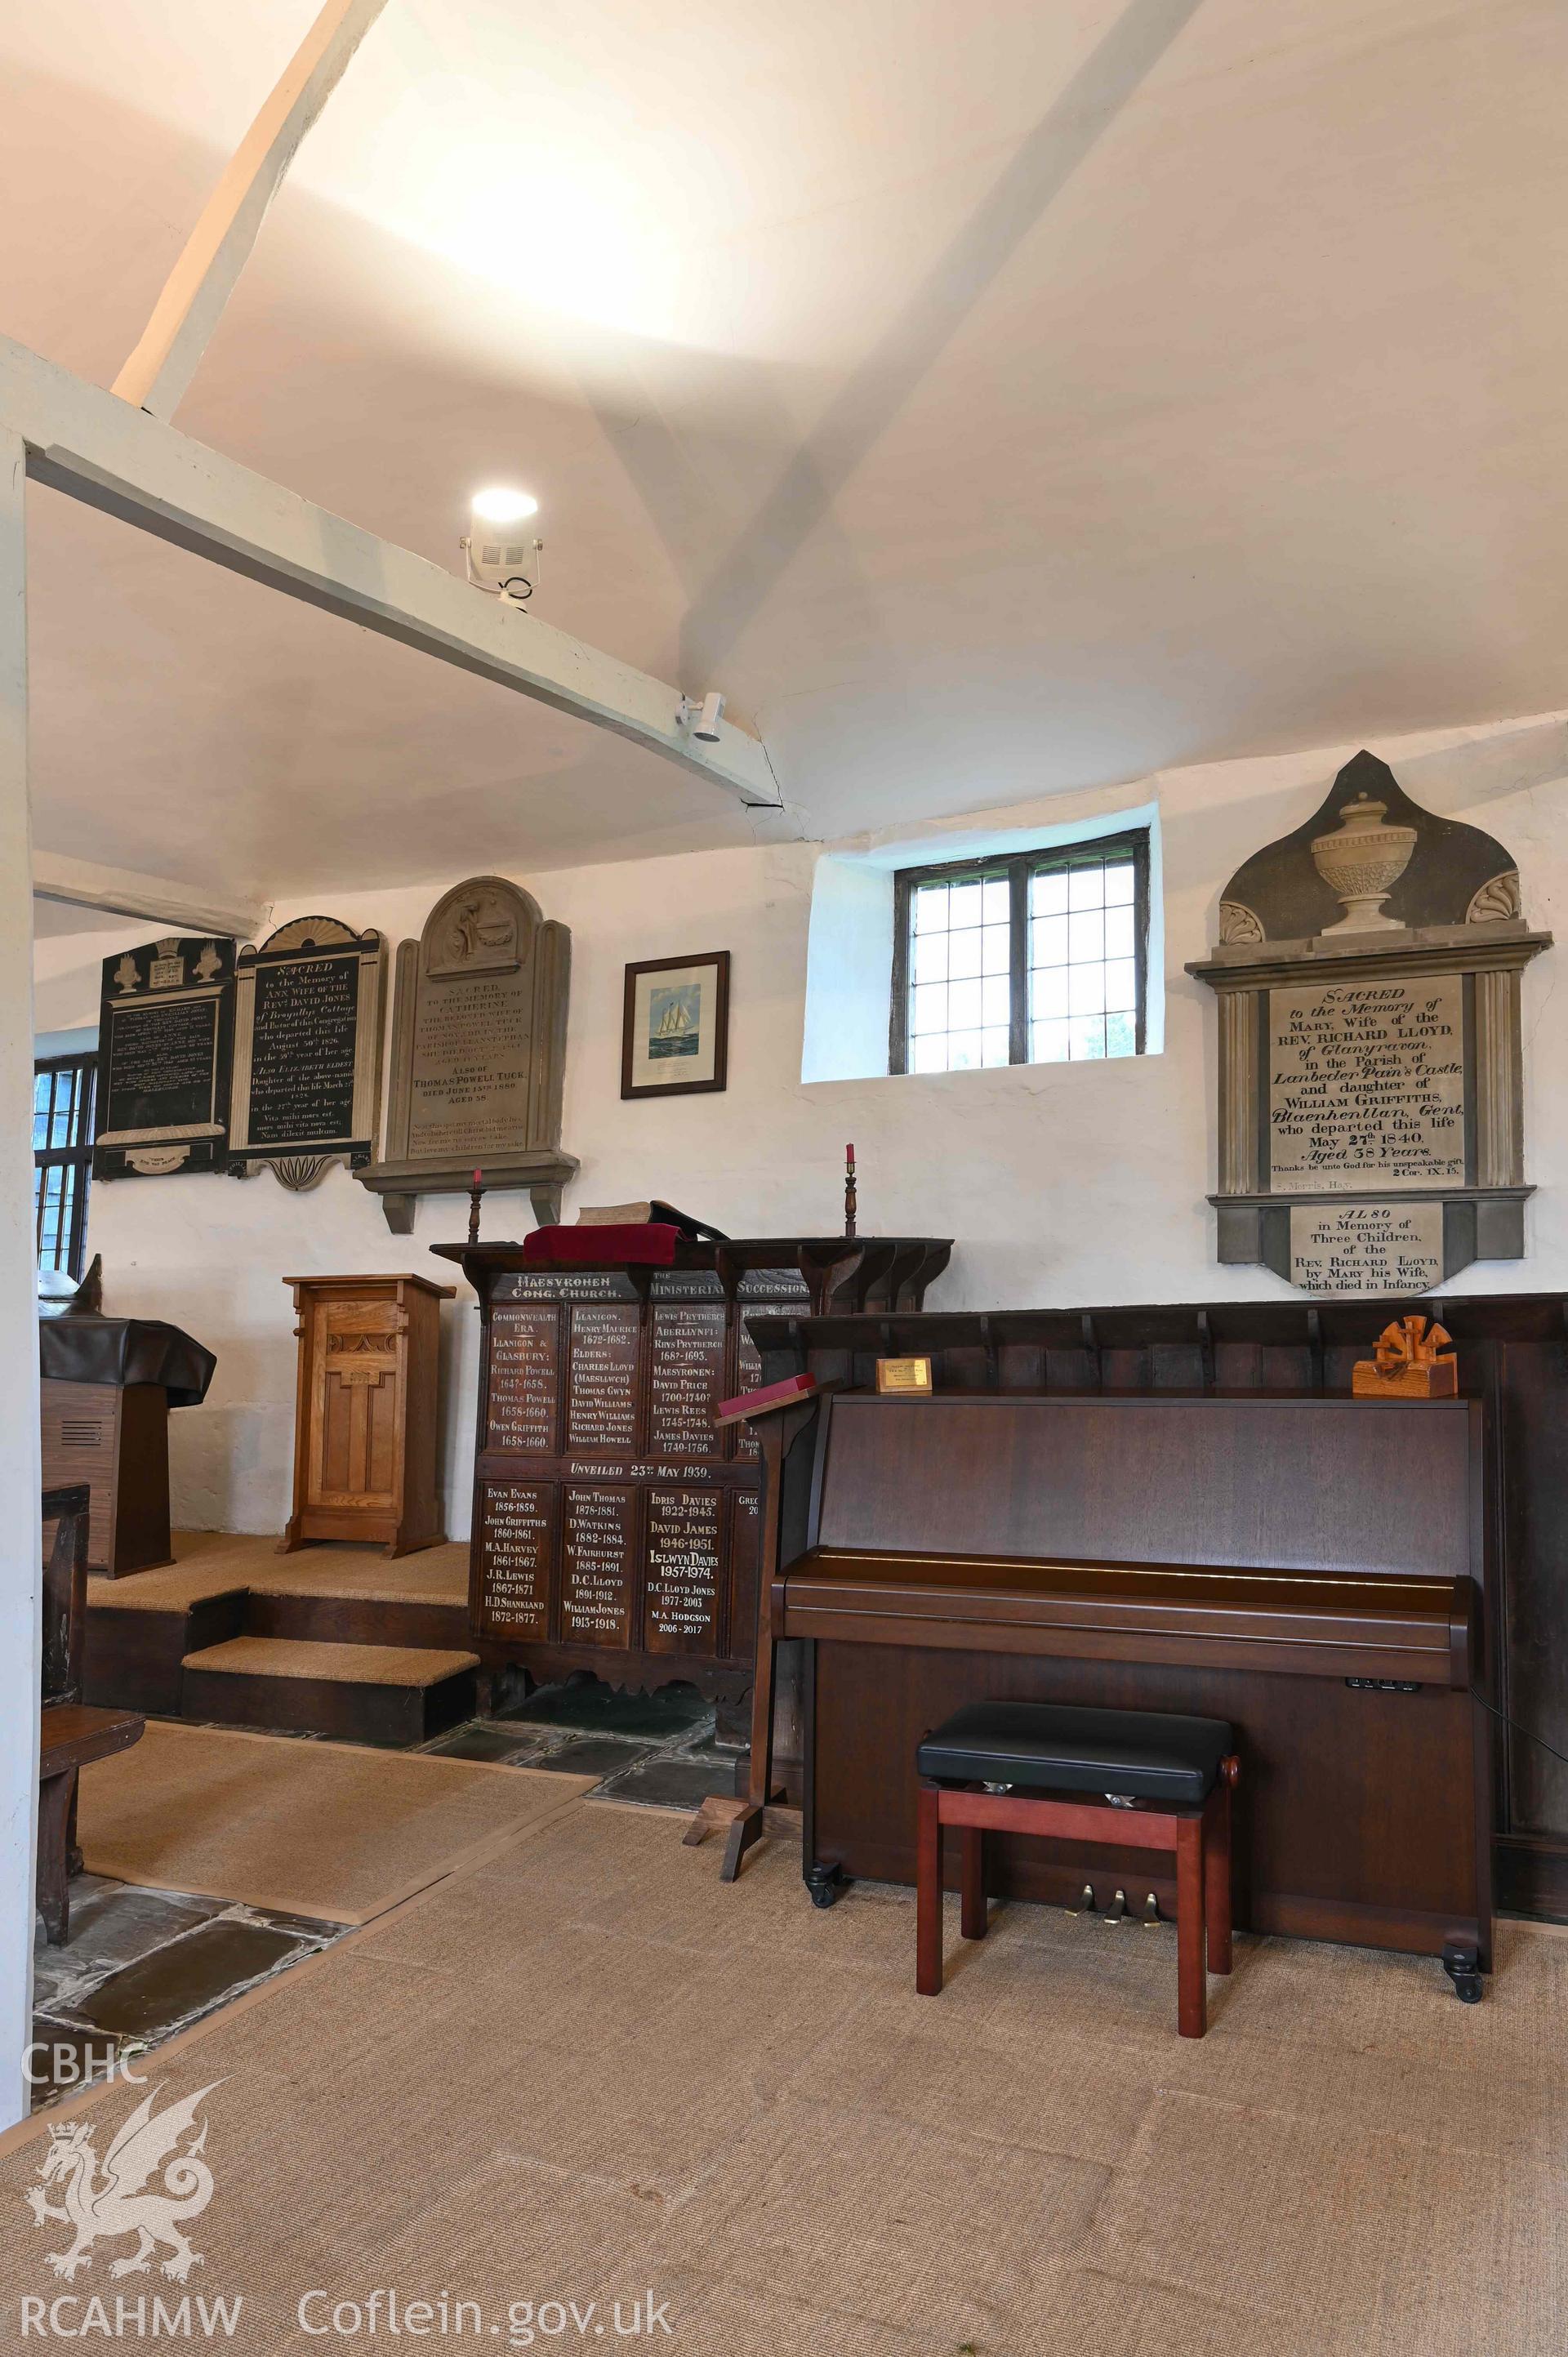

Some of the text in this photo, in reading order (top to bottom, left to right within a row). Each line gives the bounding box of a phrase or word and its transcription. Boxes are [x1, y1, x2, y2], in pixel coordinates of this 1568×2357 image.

[1321, 988, 1405, 1004] SACRED
[1290, 997, 1442, 1018] to the Memory of
[1343, 1017, 1377, 1027] Wife
[1392, 1014, 1405, 1025] of
[1416, 1012, 1438, 1023] the
[1317, 1029, 1388, 1043] RICHARD
[1298, 1045, 1316, 1060] of
[1306, 1053, 1426, 1070] in the Parish of
[1300, 1077, 1431, 1094] and daughter of
[1285, 1097, 1349, 1109] WILLIAM
[1278, 1117, 1454, 1135] who departed this life
[1309, 1137, 1340, 1149] May
[1301, 1148, 1348, 1164] Aged
[1339, 1210, 1391, 1219] ALSO
[1319, 1220, 1411, 1232] in Memory of
[1311, 1233, 1350, 1244] Three
[1343, 1244, 1386, 1254] of the
[1330, 1257, 1388, 1267] RICHARD
[1307, 1269, 1321, 1280] by
[1328, 1268, 1364, 1278] MARY
[1371, 1268, 1391, 1277] his
[1298, 1280, 1331, 1290] which
[1336, 1279, 1361, 1290] died
[1367, 1279, 1378, 1289] in
[574, 1324, 637, 1333] HENRY MAURICE
[573, 1348, 612, 1358] ELDERS:
[572, 1362, 634, 1371] CHARLES LLOYD
[573, 1385, 630, 1395] THOMAS GWYN
[572, 1398, 632, 1408] DAVID WILLIAMS
[570, 1410, 635, 1420] HENRY WILLIAMS
[572, 1422, 633, 1432] RICHARD JONES
[569, 1433, 631, 1443] WILLIAM HOWELL
[571, 1463, 622, 1475] UNVEILED
[657, 1466, 679, 1477] MAY
[683, 1466, 711, 1478] 1939.
[488, 1488, 537, 1499] EVAN EVANS
[569, 1490, 626, 1503] JOHN THOMAS
[651, 1492, 717, 1506] IDRIS DAVIES
[485, 1516, 546, 1527] JOHN GRIFFITHS
[650, 1522, 717, 1535] DAVID JAMES
[650, 1550, 719, 1566] ISLWYN DAVIES
[492, 1583, 533, 1595] 1867-1871
[692, 1584, 715, 1596] JONES
[564, 1600, 625, 1615] WILLIAM JONES
[662, 1596, 702, 1607] 1977-2003
[671, 1612, 710, 1622] HODGSON
